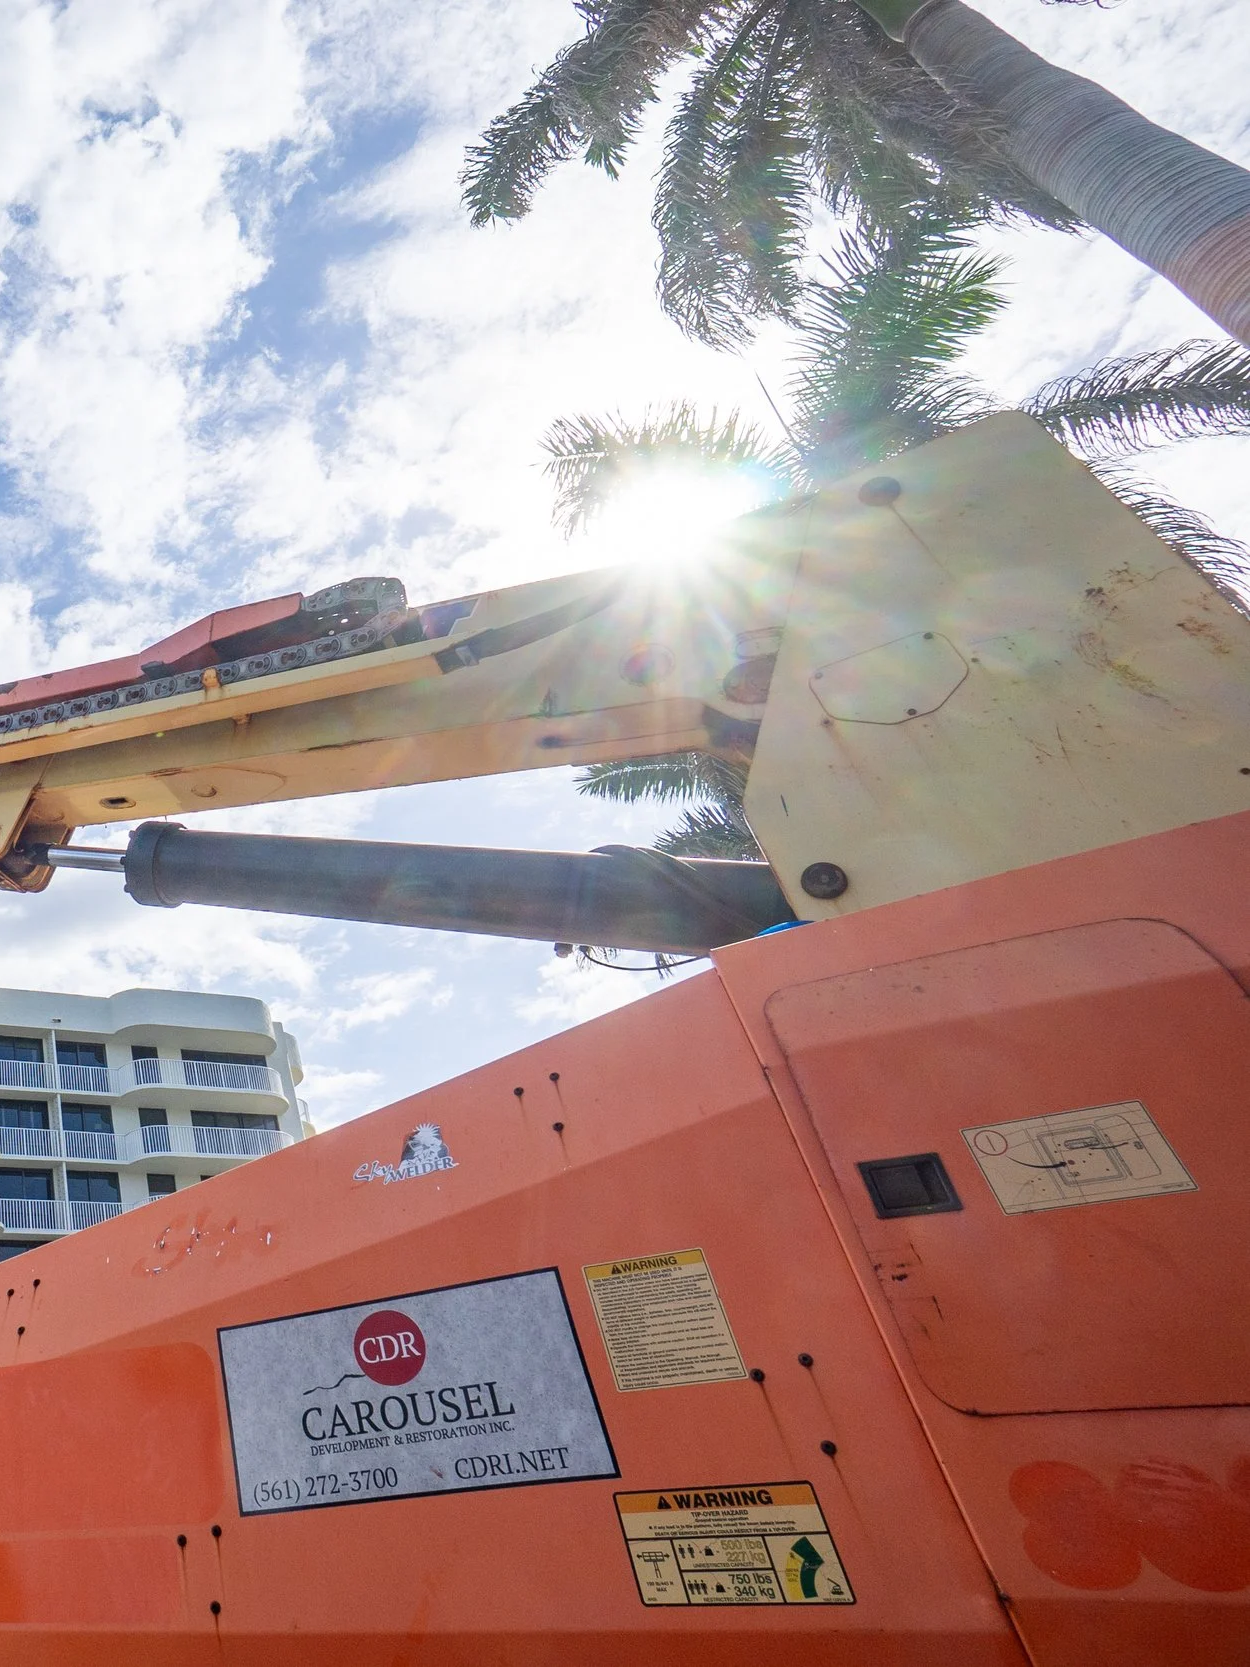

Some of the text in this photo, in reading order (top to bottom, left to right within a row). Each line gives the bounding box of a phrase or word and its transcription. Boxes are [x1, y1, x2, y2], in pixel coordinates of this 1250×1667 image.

[620, 1255, 677, 1272] WARNING
[359, 1331, 421, 1364] CDR
[301, 1381, 516, 1441] CAROUSEL
[310, 1419, 516, 1457] DEVELOPMENT & RESTORATION INC.
[454, 1447, 569, 1480] CDRI.NET
[253, 1466, 399, 1506] (561) 272-3700
[672, 1489, 773, 1508] WARNING
[719, 1538, 763, 1550] 500 lbs
[724, 1550, 767, 1564] 227 kg
[727, 1573, 751, 1584] 750
[752, 1572, 773, 1583] lbs
[733, 1584, 776, 1598] 340 kg
